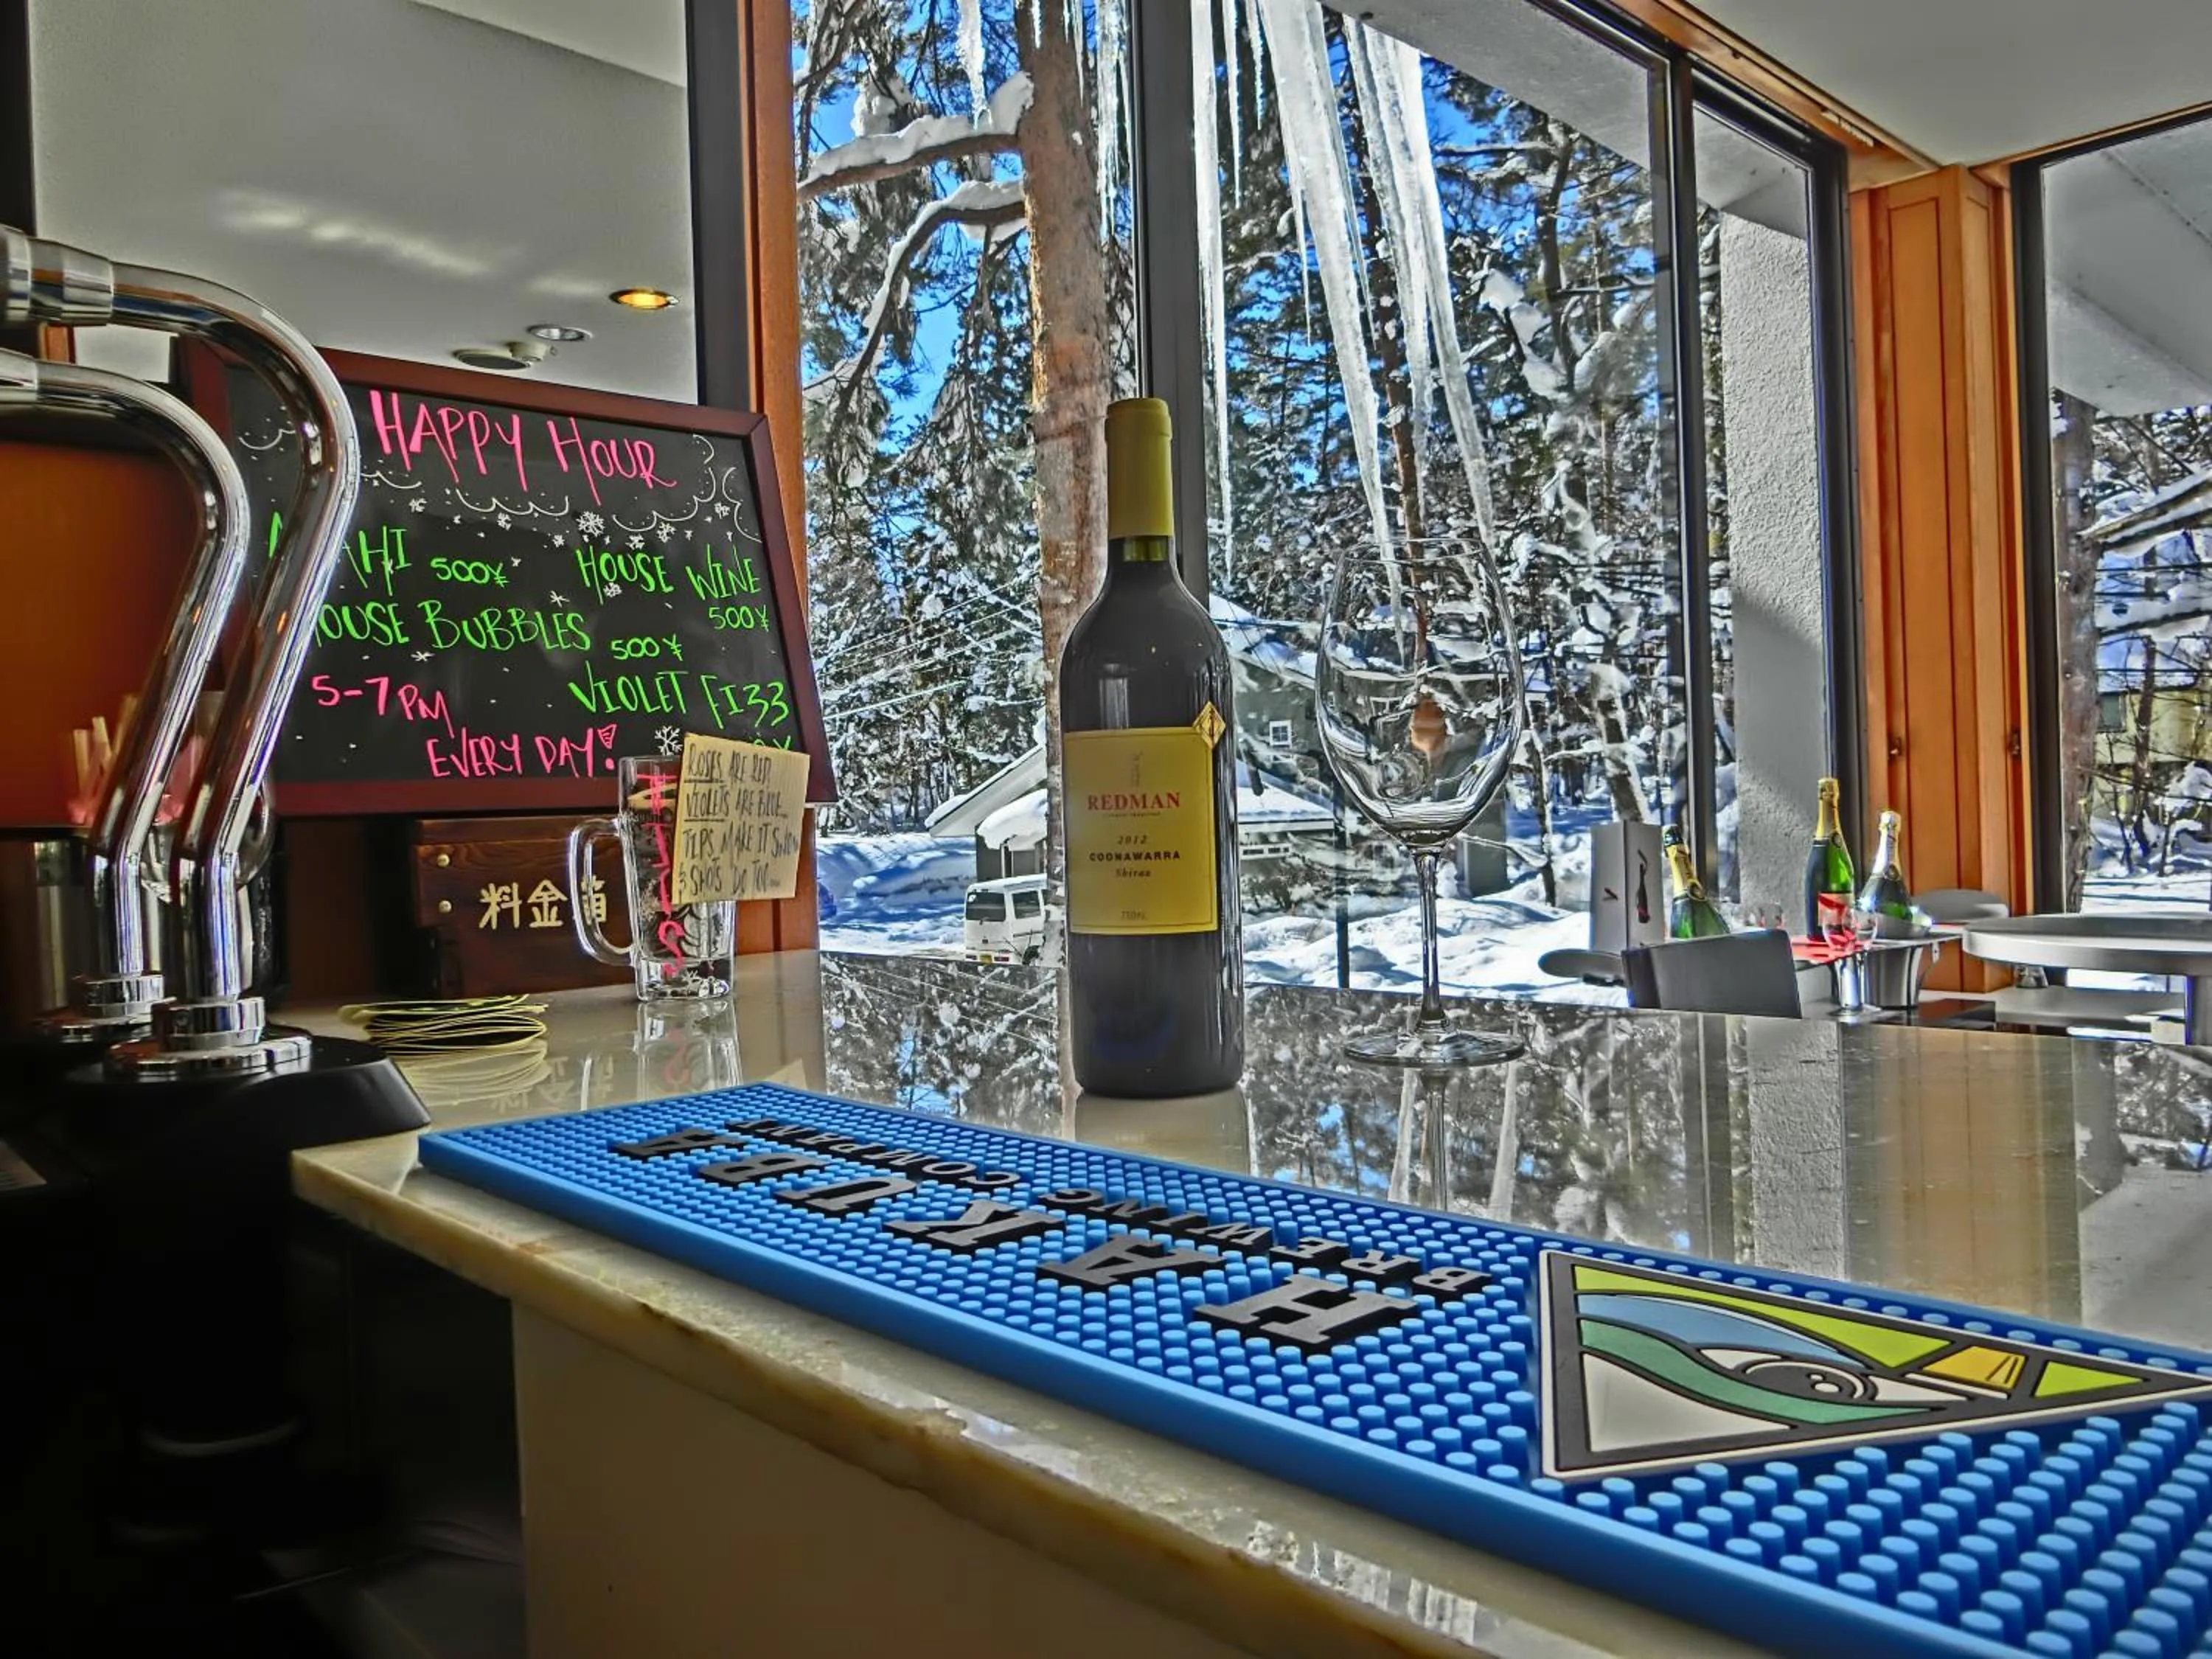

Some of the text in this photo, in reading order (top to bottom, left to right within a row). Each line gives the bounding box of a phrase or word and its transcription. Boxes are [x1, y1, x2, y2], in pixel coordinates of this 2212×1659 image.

[370, 390, 676, 505] HAPPY HOUR
[430, 557, 509, 588] 500¥
[575, 544, 761, 603] HOUSE WINE
[315, 599, 591, 653] OUSE BUBBLES
[708, 604, 770, 632] 500¥
[611, 634, 683, 661] 500¥
[312, 675, 454, 737] 5-7 PM
[568, 661, 689, 714] VIOLET
[427, 728, 523, 778] EVERY
[688, 742, 723, 777] ROSES
[730, 751, 747, 784] ARE
[686, 785, 731, 818] VIOLETS
[1088, 791, 1180, 810] REDMAN
[683, 827, 714, 860] TIPS
[1089, 850, 1180, 862] COONAWARRA
[1117, 835, 1148, 845] 2012
[1116, 866, 1152, 877] Shiraz
[725, 1117, 1493, 1294] BREWING COMPANY
[609, 1127, 1421, 1348] HAKUBA
